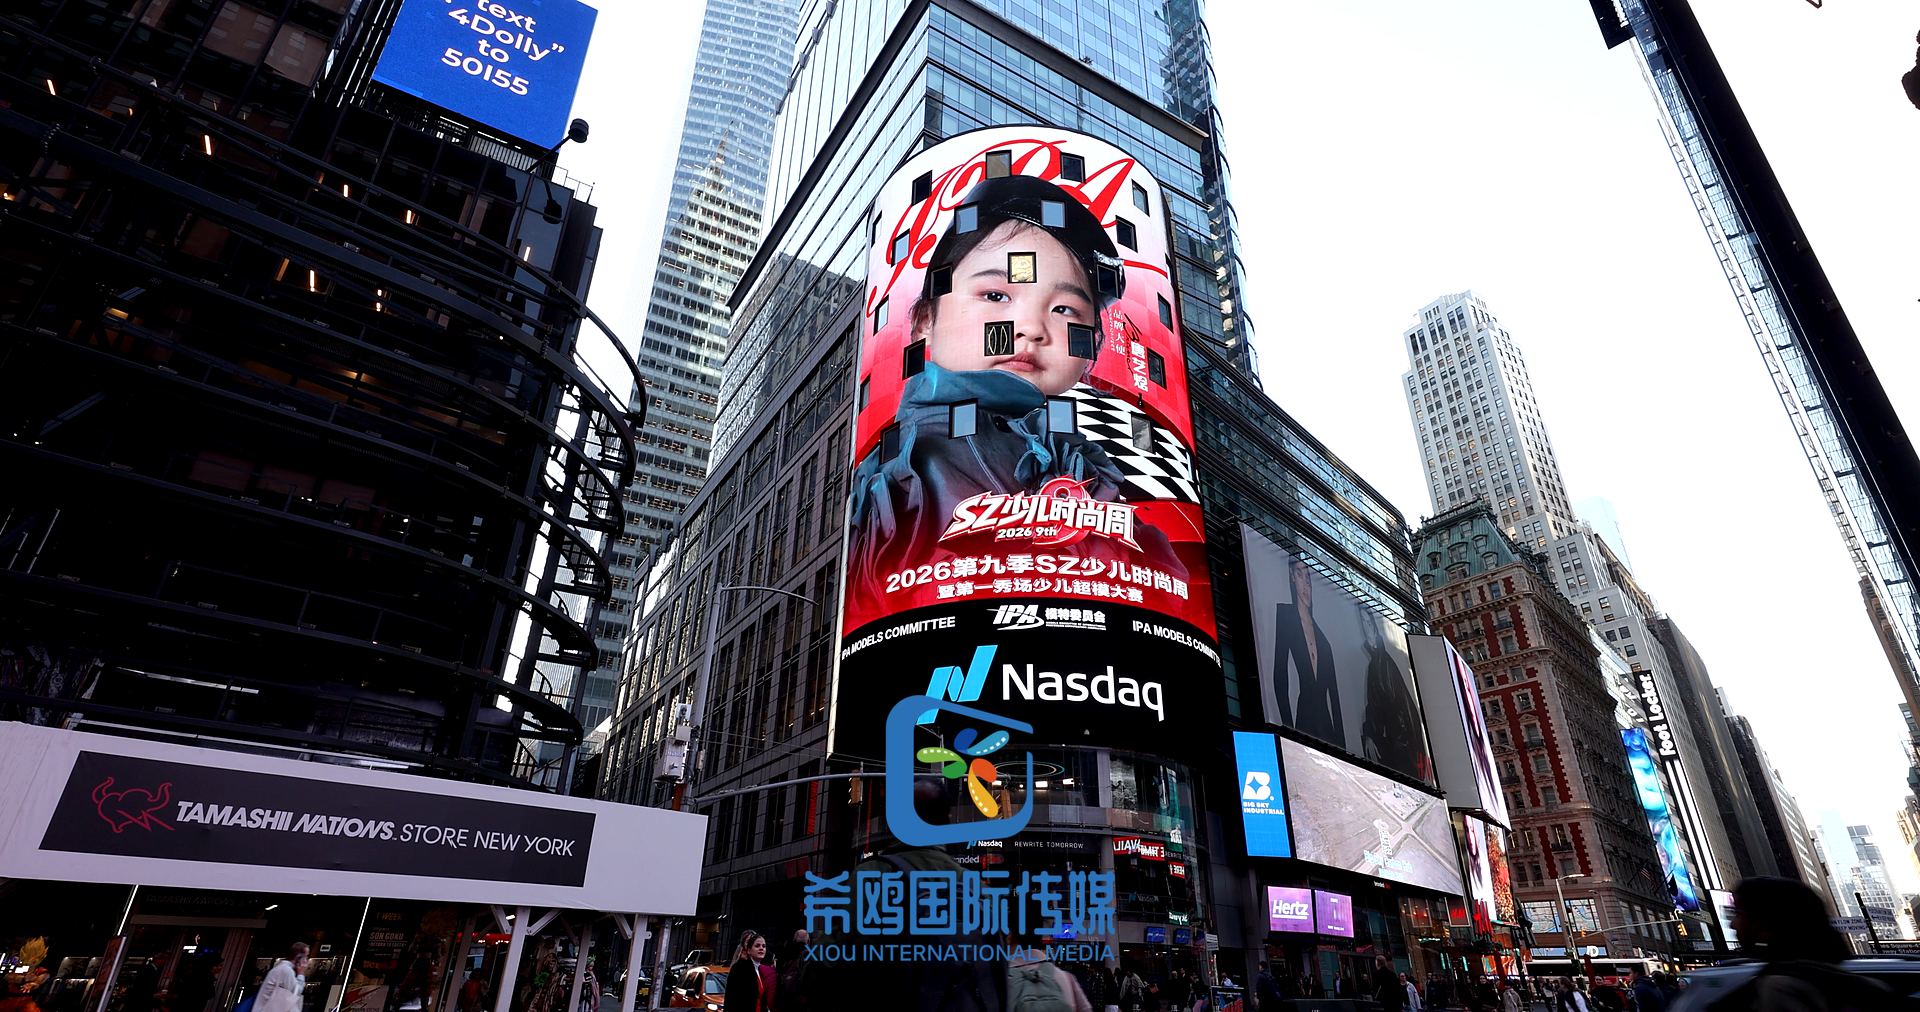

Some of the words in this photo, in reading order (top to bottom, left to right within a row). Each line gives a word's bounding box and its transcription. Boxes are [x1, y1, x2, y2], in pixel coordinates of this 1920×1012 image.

[477, 0, 537, 33] text
[478, 39, 510, 63] to
[441, 47, 530, 96] 50155
[997, 527, 1033, 539] 2026
[1036, 526, 1058, 538] 9th
[992, 604, 1040, 625] IPA
[851, 632, 884, 654] MODELS
[884, 616, 956, 640] COMMITTEE
[1132, 619, 1152, 635] IPA
[1153, 624, 1193, 647] MODELS
[1002, 663, 1165, 722] Nasdaq
[1652, 722, 1677, 756] Foot
[176, 800, 294, 832] TAMASHII
[292, 813, 396, 841] NATIONS
[400, 823, 470, 849] STORE
[473, 830, 521, 851] NEW
[523, 835, 576, 857] YORK
[977, 840, 1003, 848] Nasdaq
[1046, 841, 1084, 849] TOMORROW
[1271, 899, 1310, 916] Hertz
